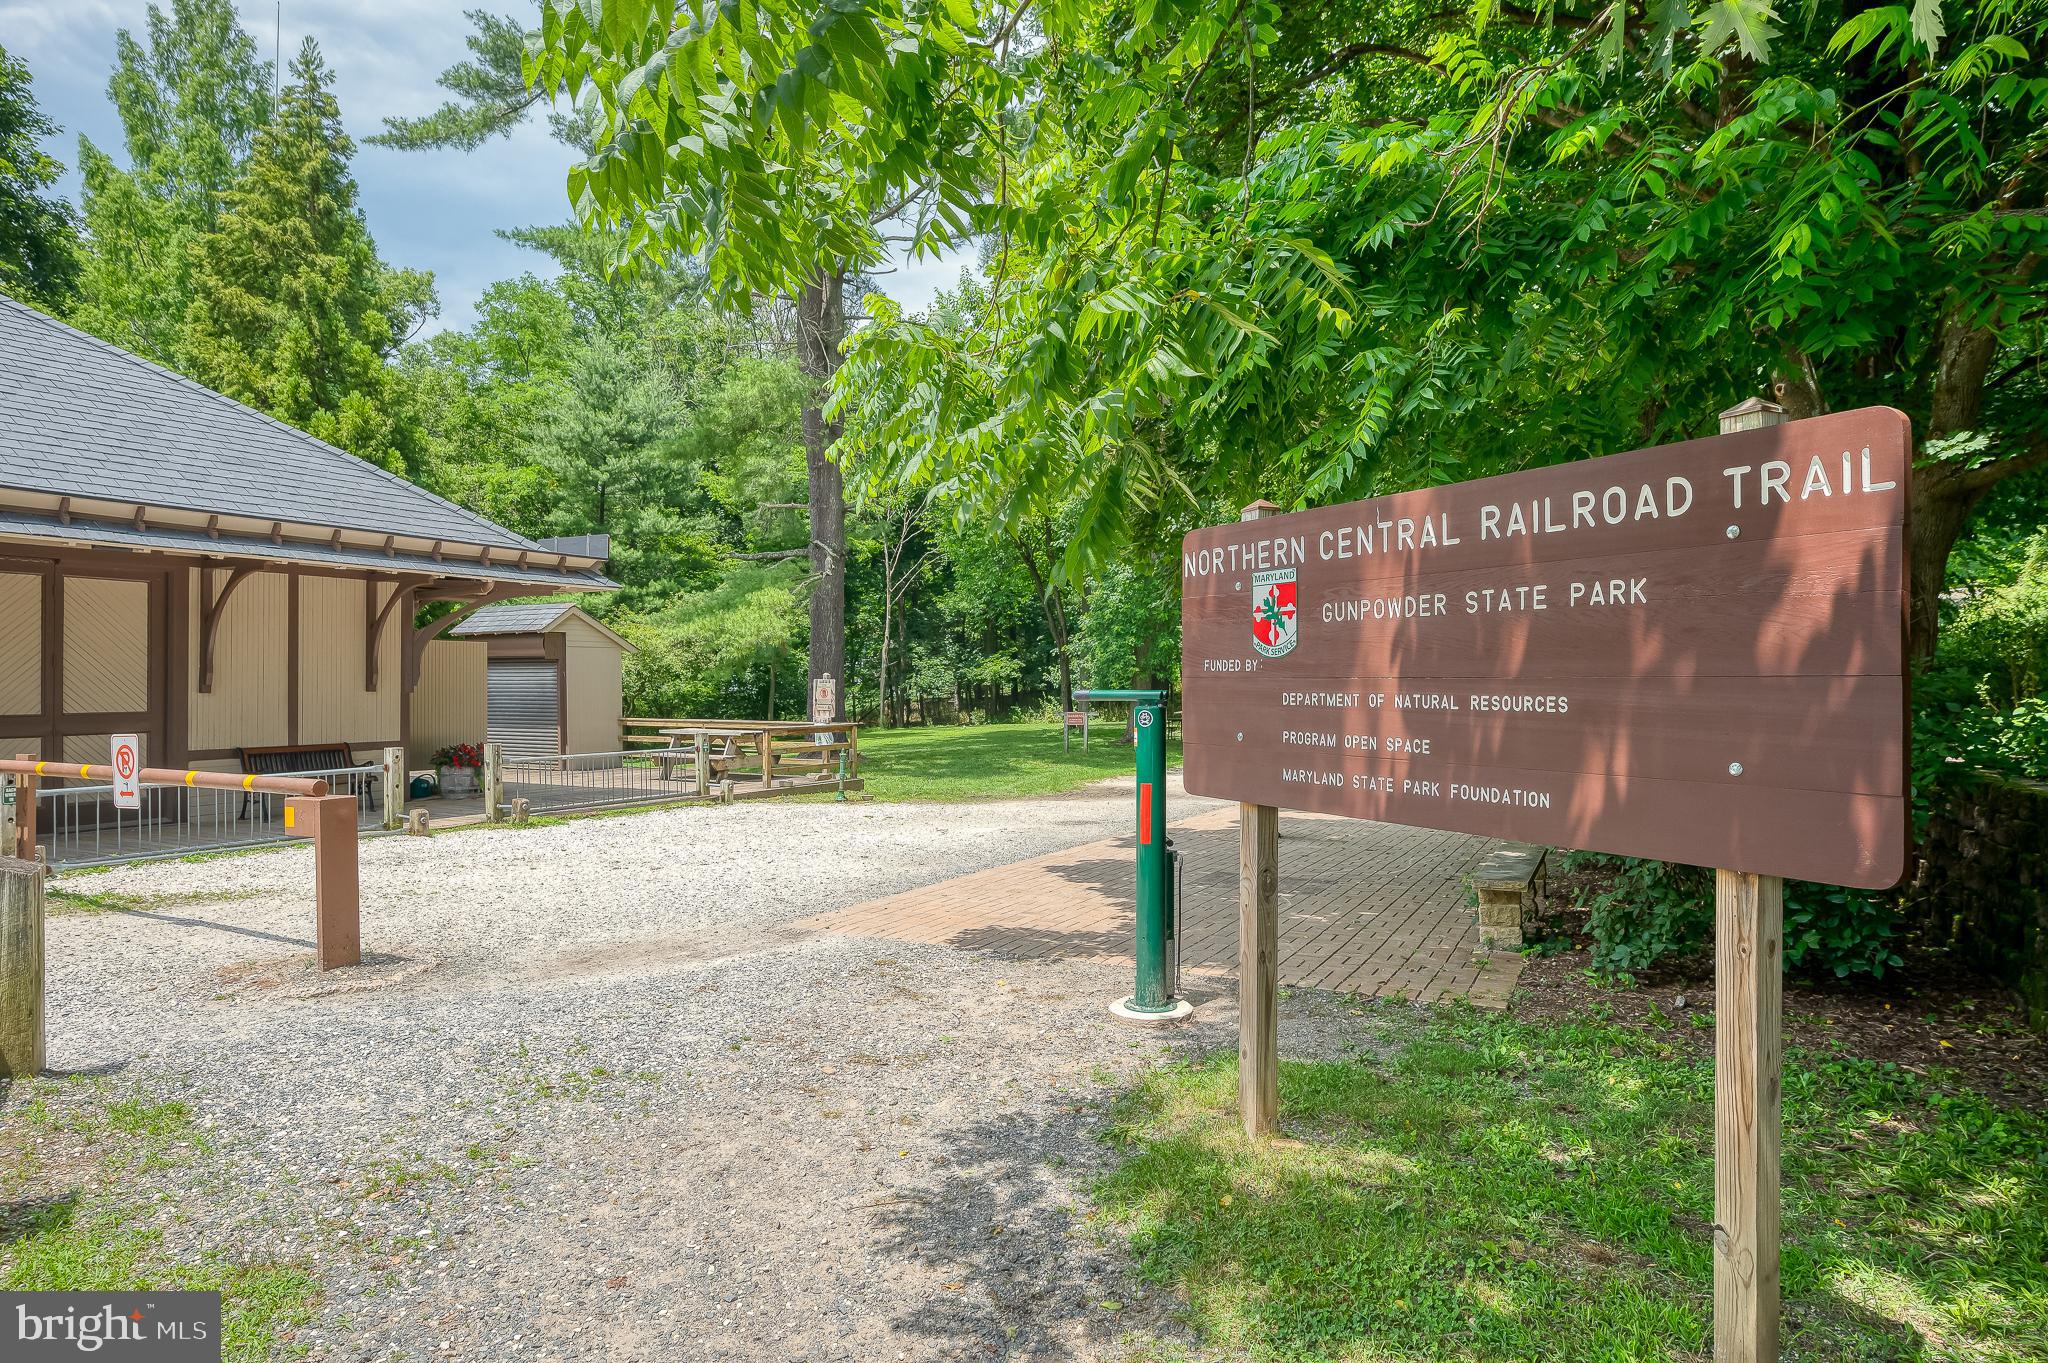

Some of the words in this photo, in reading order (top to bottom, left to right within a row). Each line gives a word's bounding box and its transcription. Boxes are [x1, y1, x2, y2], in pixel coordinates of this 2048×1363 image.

[1183, 535, 1305, 578] NORTHERN
[1318, 512, 1461, 561] CENTRAL
[1480, 476, 1693, 541] RAILROAD
[1722, 447, 1897, 509] TRAIL
[1254, 571, 1295, 583] MARYLAND
[1322, 593, 1447, 624] GUNPOWDER
[1465, 584, 1548, 614] STATE
[1570, 577, 1647, 608] PARK
[1256, 641, 1270, 654] PARK
[1270, 640, 1295, 656] SERVICE
[1203, 658, 1242, 672] FUNDED
[1282, 692, 1360, 708] DEPARTMENT
[1368, 693, 1385, 708] OF
[1393, 693, 1459, 710] NATURAL
[1470, 694, 1569, 714] RESOURCES
[1282, 730, 1337, 748] PROGRAM
[1344, 734, 1377, 751] OPEN
[1385, 735, 1431, 755] SPACE
[1282, 768, 1344, 788] MARYLAND
[1351, 774, 1394, 793] STATE
[1403, 779, 1440, 797] PARK
[1450, 783, 1550, 809] FOUNDATION
